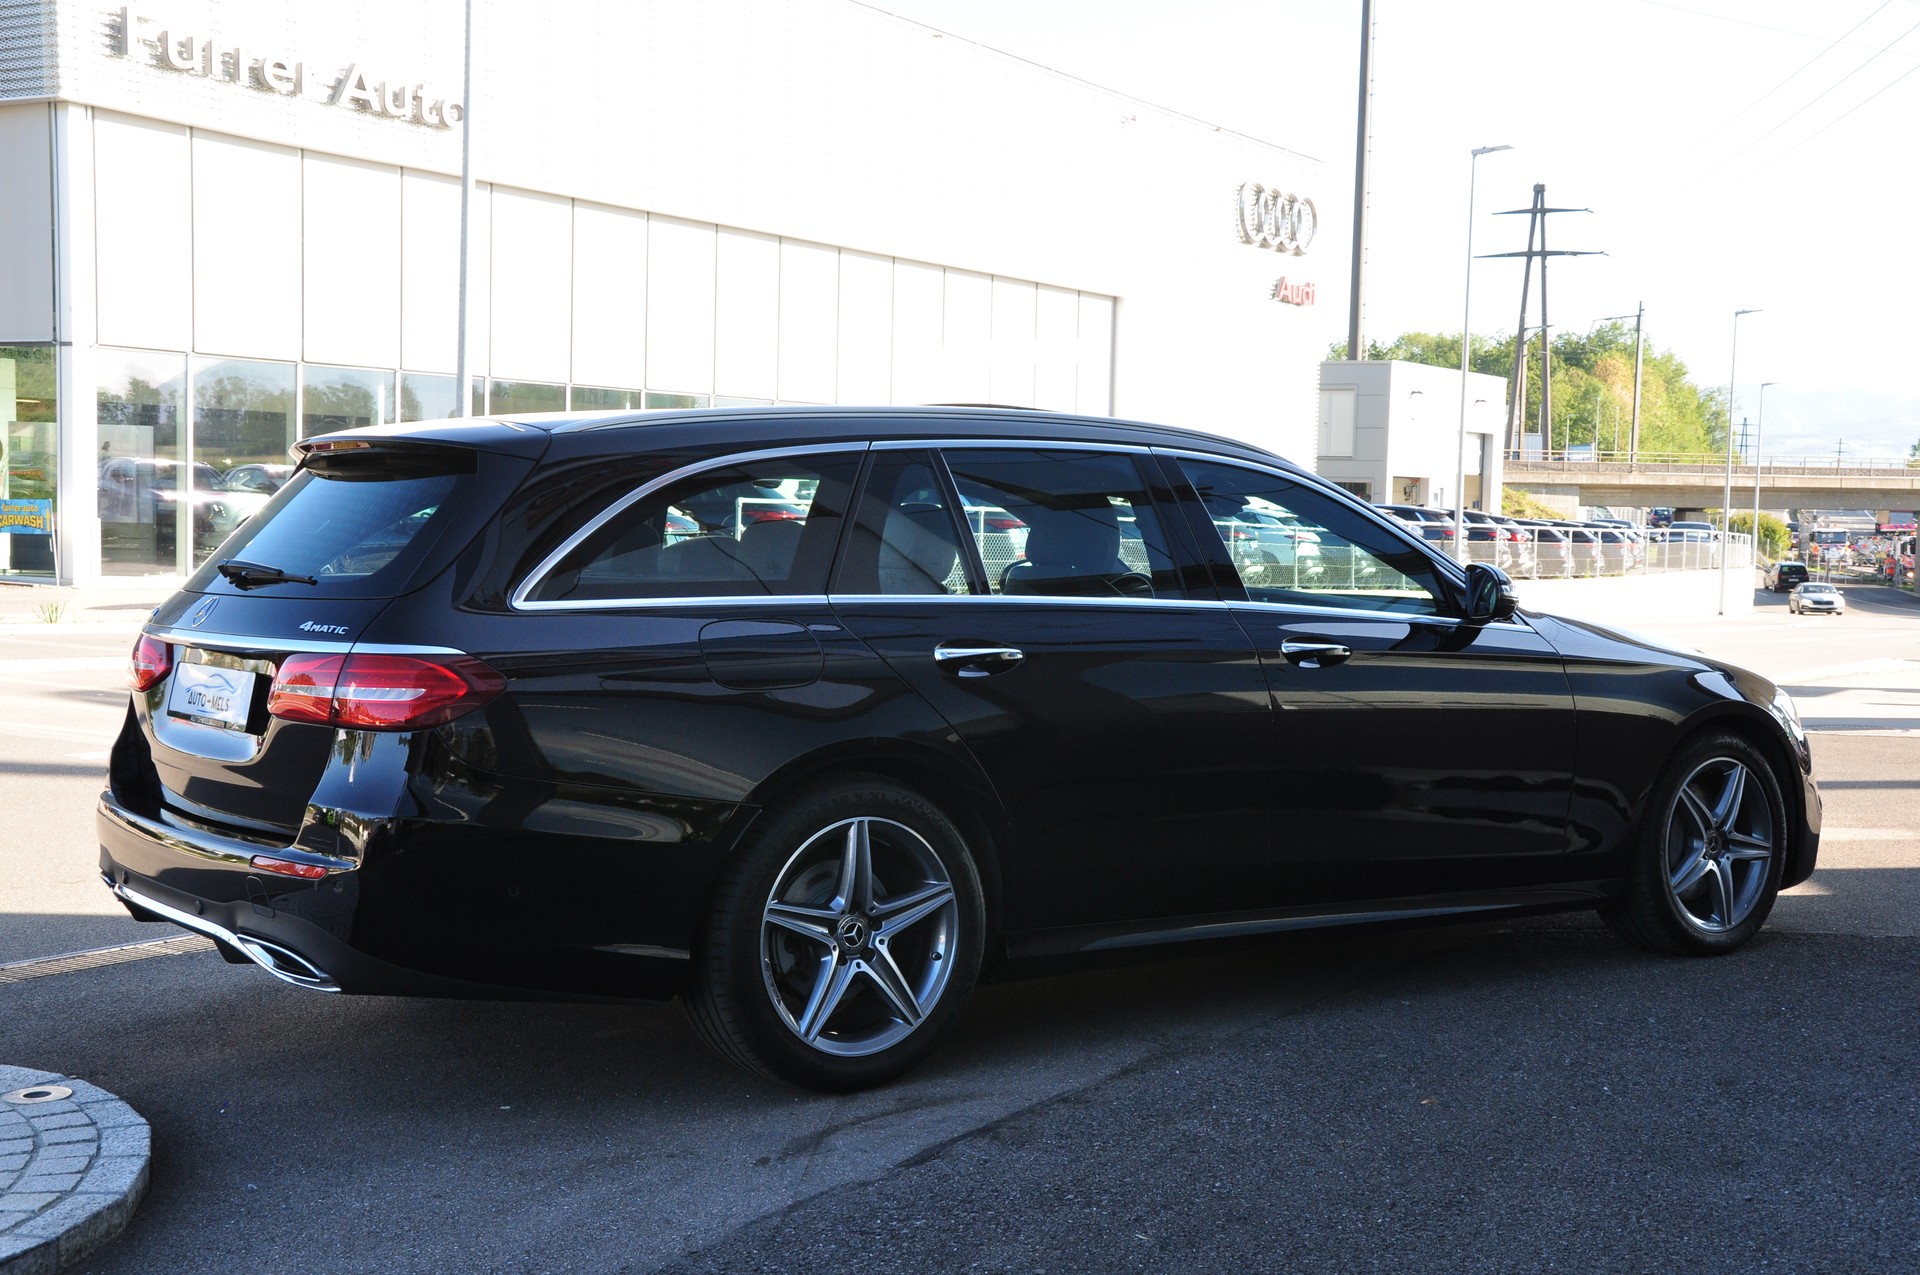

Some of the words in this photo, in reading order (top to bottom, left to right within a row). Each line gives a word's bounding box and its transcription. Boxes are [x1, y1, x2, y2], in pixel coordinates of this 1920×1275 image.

[330, 62, 464, 129] Auto
[1275, 276, 1315, 306] Audi
[299, 621, 349, 634] 4MATIC
